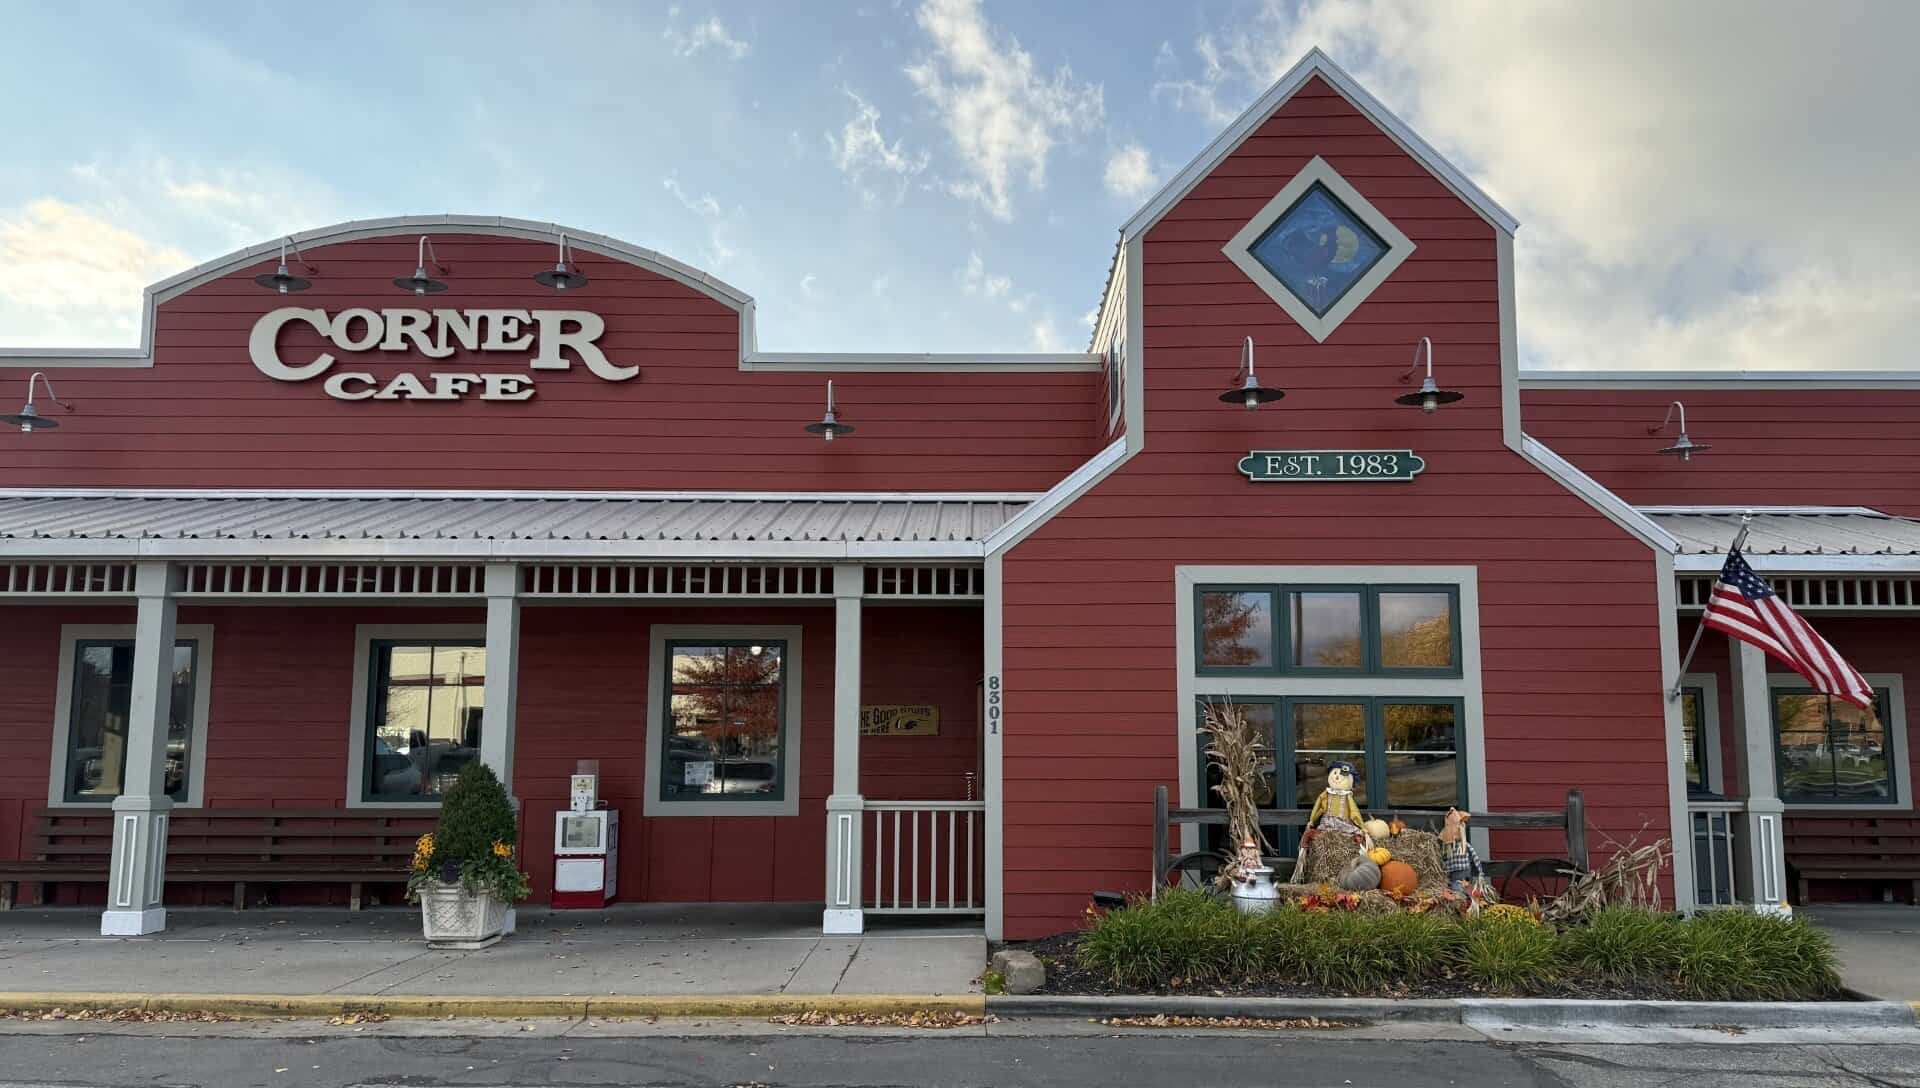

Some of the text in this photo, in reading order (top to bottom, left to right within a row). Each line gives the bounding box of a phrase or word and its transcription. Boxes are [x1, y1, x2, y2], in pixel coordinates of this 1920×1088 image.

[249, 307, 640, 382] CORNER
[323, 372, 537, 401] CAFE
[1264, 454, 1399, 475] EST. 1983
[988, 676, 1000, 734] 8301
